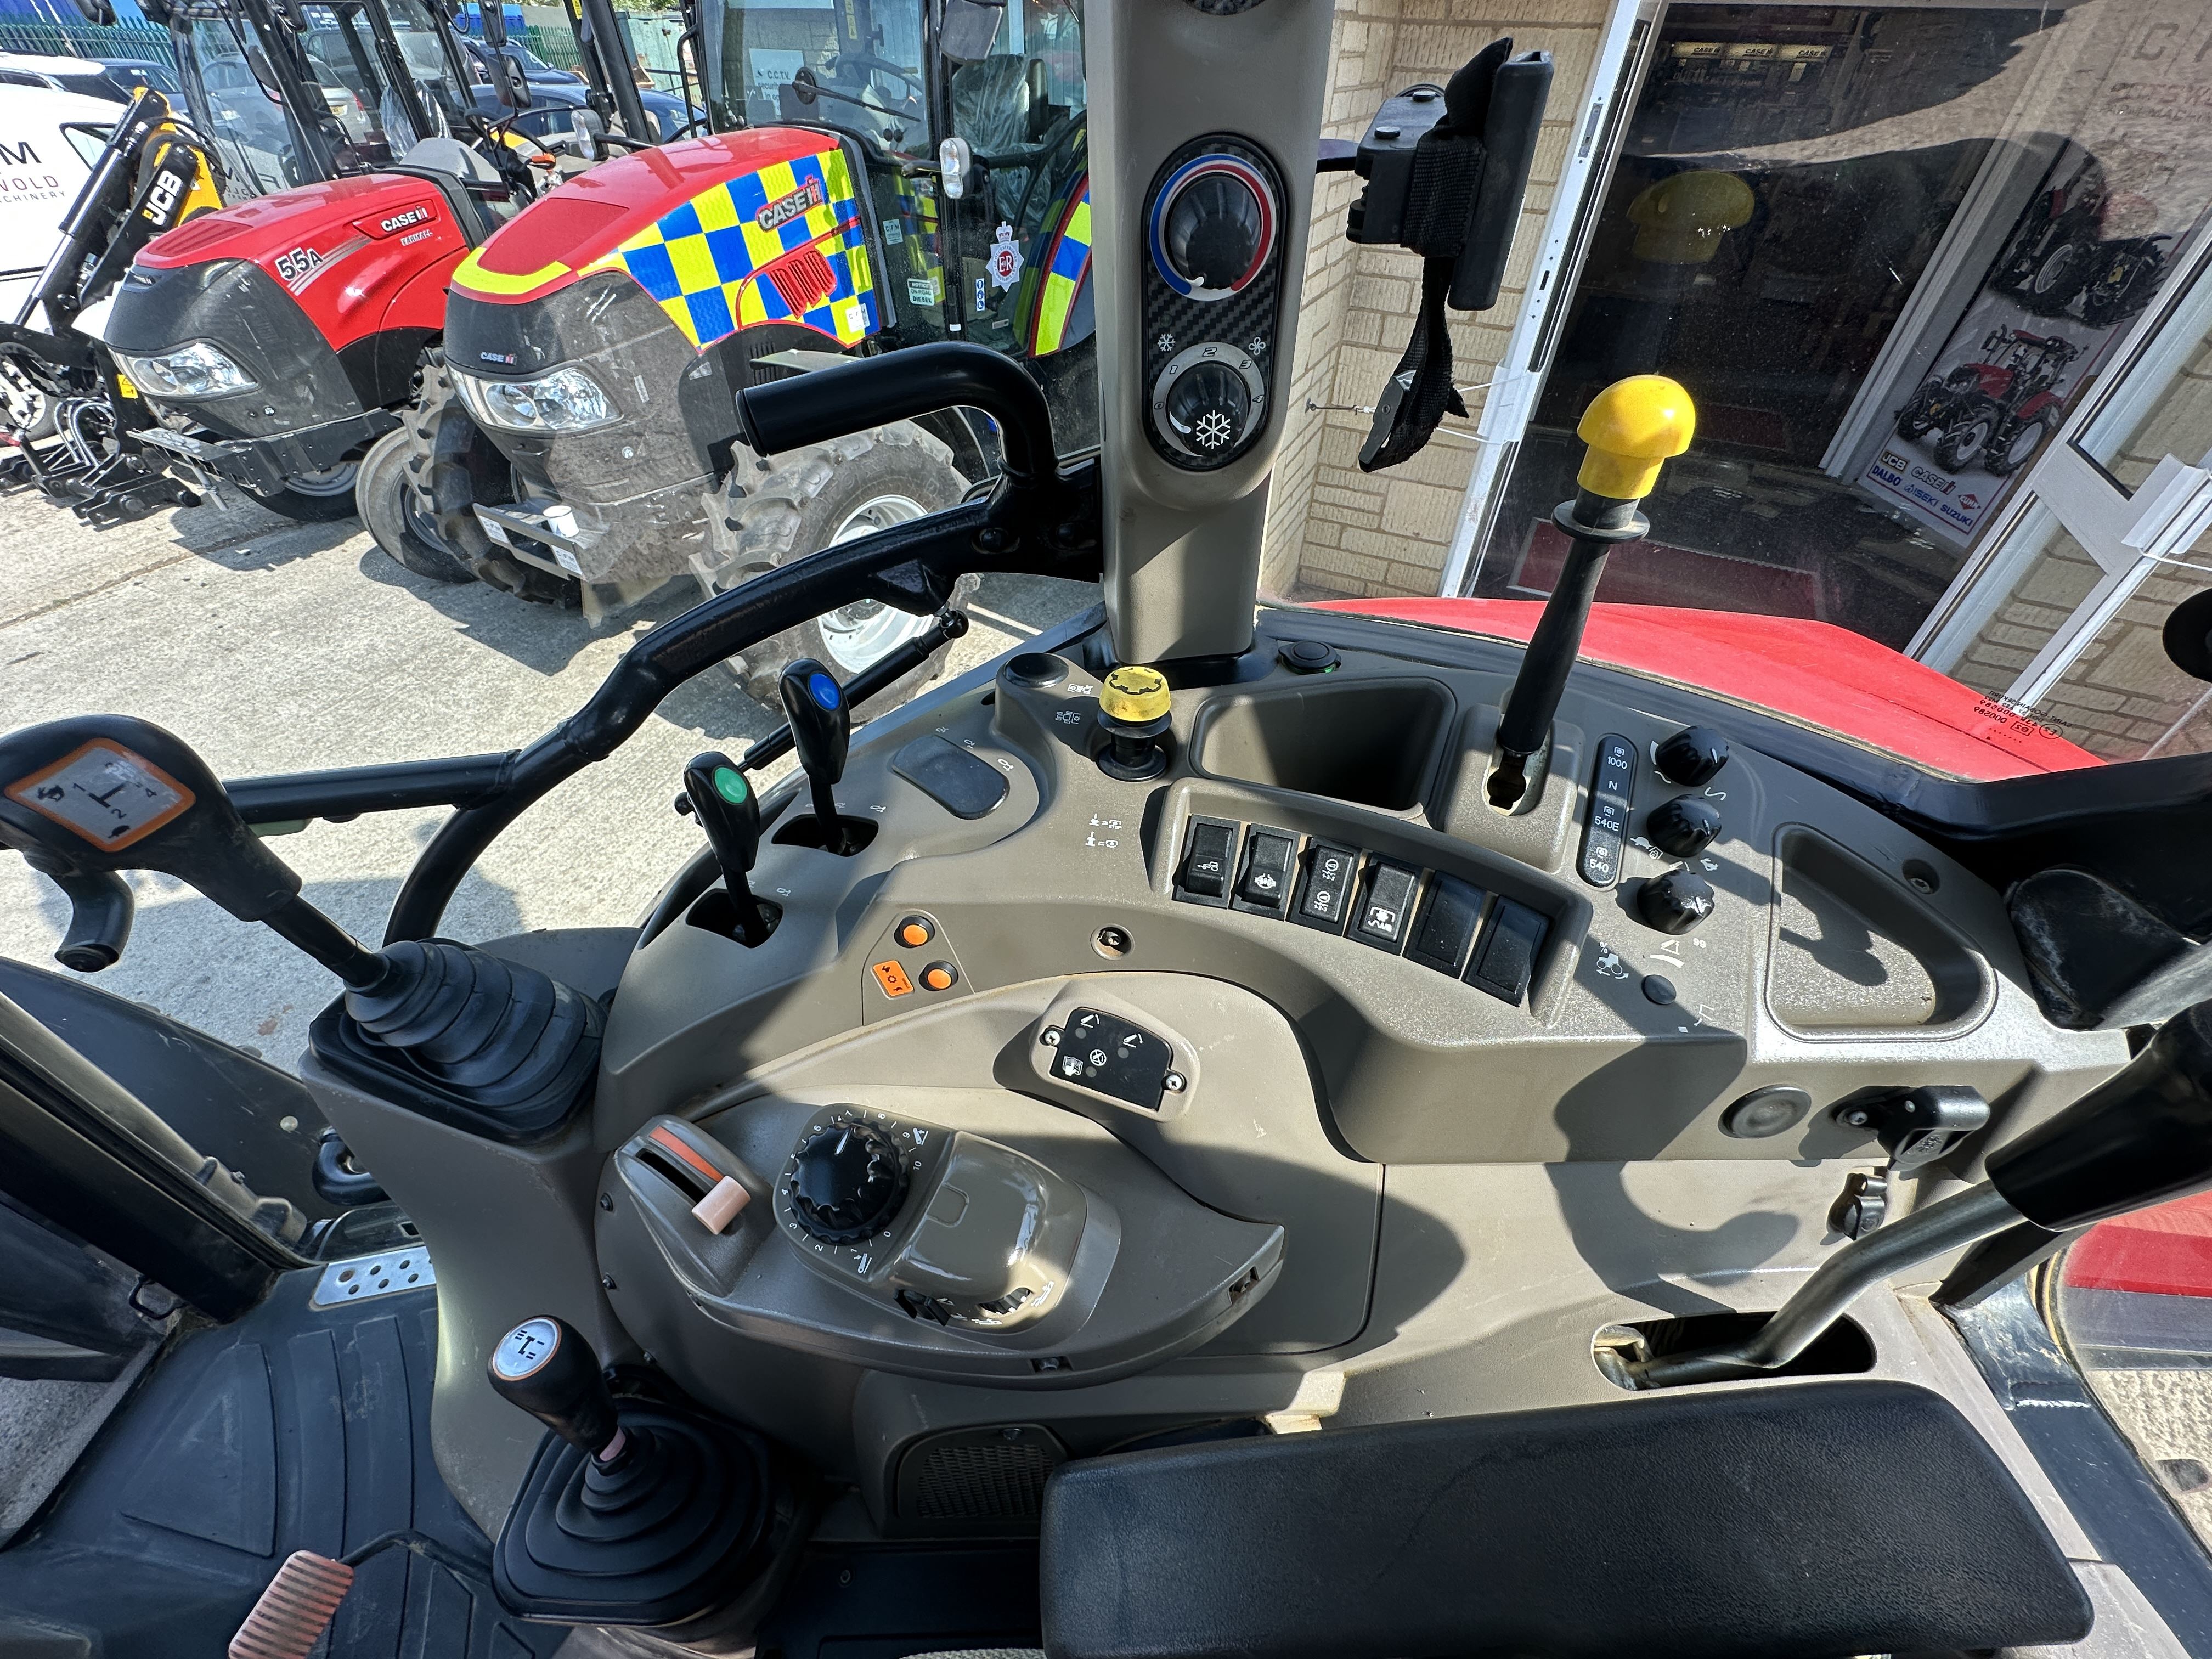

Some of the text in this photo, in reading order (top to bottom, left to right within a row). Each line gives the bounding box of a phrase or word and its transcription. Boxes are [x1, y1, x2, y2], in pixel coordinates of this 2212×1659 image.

[142, 170, 183, 226] JCB
[758, 190, 807, 229] CASE
[381, 212, 417, 232] CASE
[274, 247, 324, 281] 55A
[480, 351, 504, 362] CASE
[1202, 347, 1217, 357] 2
[1169, 365, 1178, 374] 1
[1239, 359, 1253, 369] 3
[1154, 401, 1164, 410] 0
[1251, 394, 1265, 403] 4
[1882, 453, 1906, 470] JCB
[1871, 465, 1902, 486] DALBO
[1911, 466, 1945, 492] CASE
[1912, 488, 1939, 507] ISEKI
[1959, 494, 1979, 509] KUHN
[1940, 504, 1974, 527] SUZUKI
[1607, 756, 1628, 770] 1000
[144, 787, 158, 798] 4
[1608, 780, 1618, 791] N
[110, 808, 127, 820] 2
[1594, 815, 1620, 832] 540E
[1589, 857, 1610, 873] 540
[913, 1160, 922, 1171] 10
